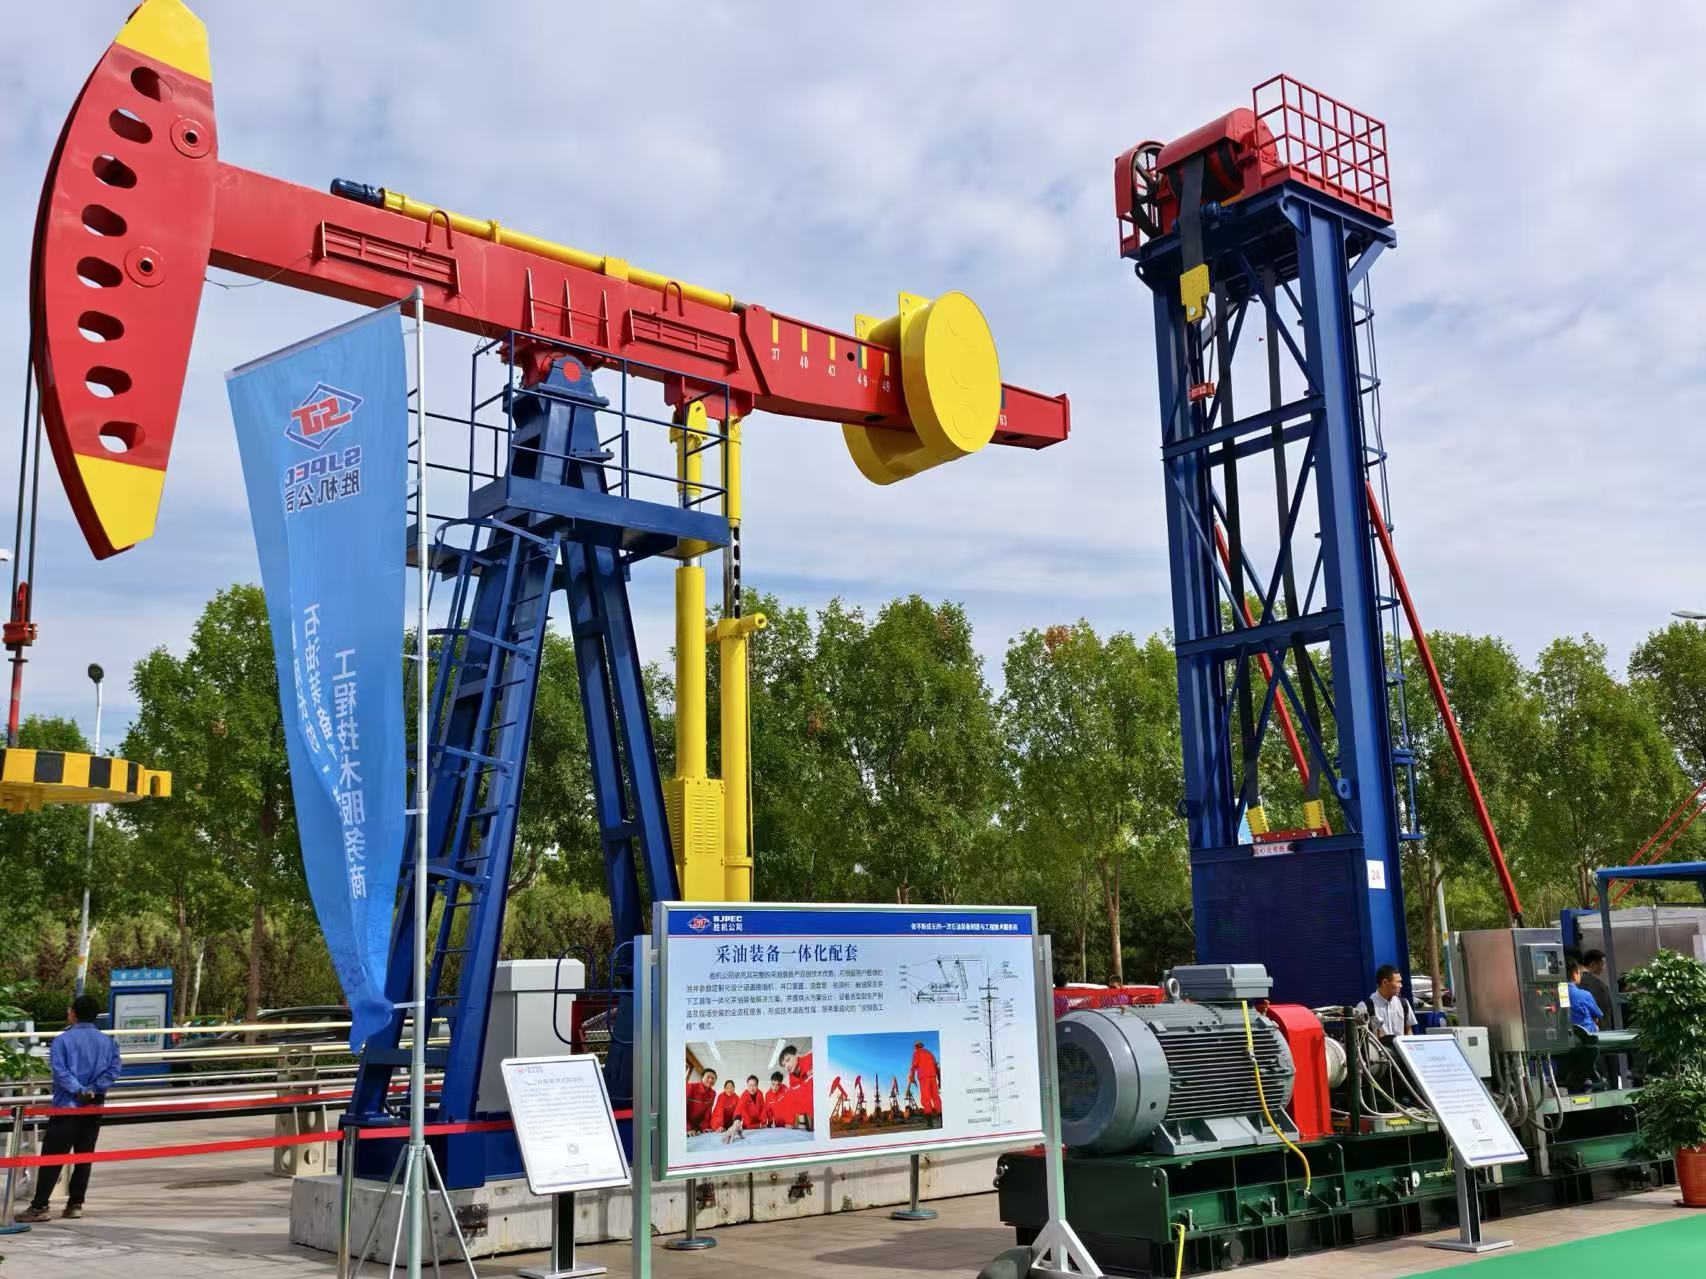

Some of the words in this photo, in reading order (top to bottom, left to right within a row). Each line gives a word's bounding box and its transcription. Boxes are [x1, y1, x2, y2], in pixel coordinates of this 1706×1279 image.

[771, 347, 780, 361] 37
[828, 365, 836, 377] 43
[713, 915, 743, 923] SJPEC
[713, 923, 743, 932] 胜机公司
[714, 943, 858, 964] 采油装备一体化配套
